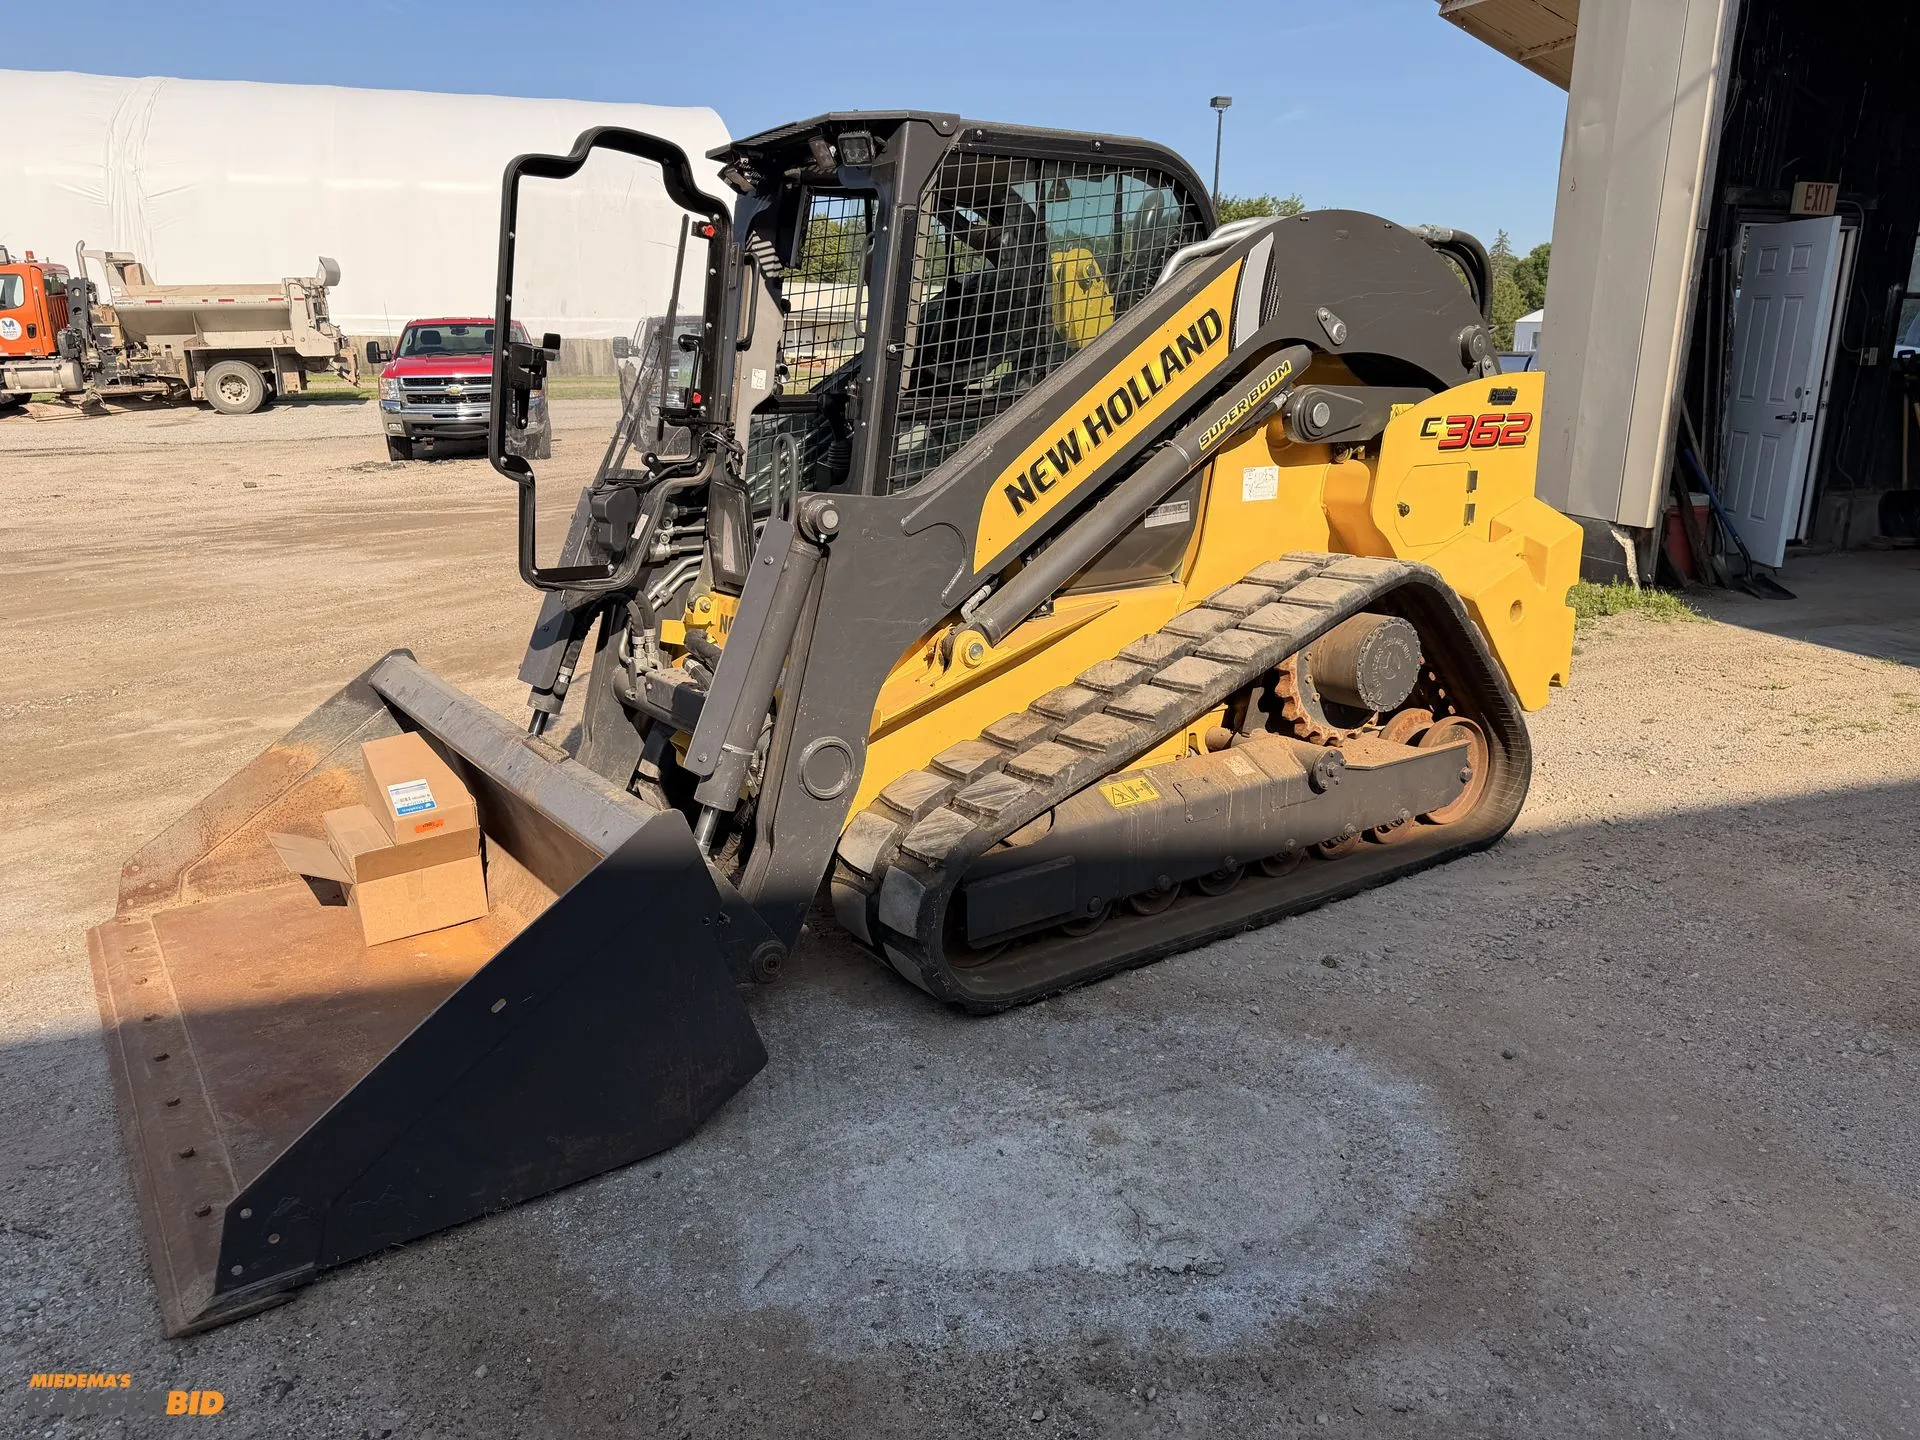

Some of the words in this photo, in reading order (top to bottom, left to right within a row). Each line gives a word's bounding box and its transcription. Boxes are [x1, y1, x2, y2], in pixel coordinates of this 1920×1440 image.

[1803, 184, 1834, 212] EXIT
[1003, 427, 1083, 516] NEW
[1082, 307, 1223, 449] HOLLAND
[1199, 398, 1250, 450] SUPER
[1247, 360, 1293, 406] BOOM
